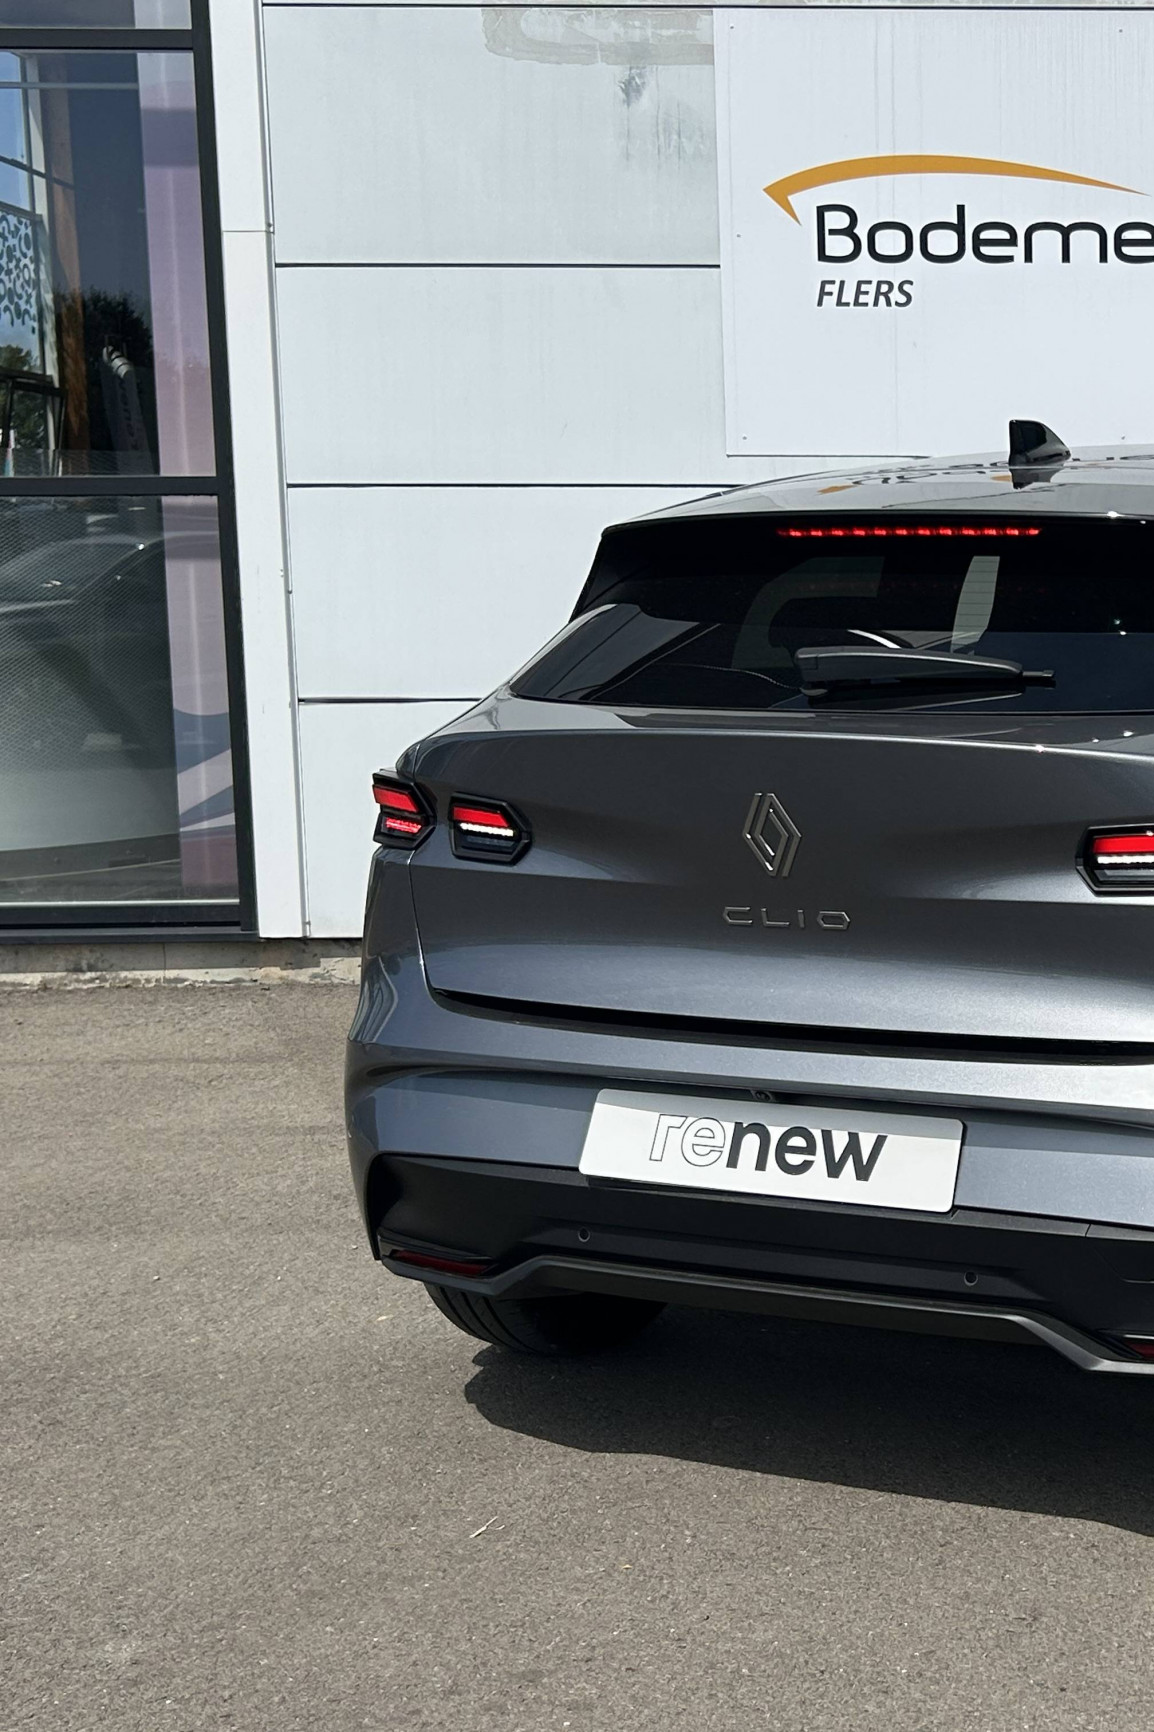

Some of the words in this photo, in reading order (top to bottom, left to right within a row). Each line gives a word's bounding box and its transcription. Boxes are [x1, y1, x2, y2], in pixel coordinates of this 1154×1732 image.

[817, 280, 913, 308] FLERS
[723, 907, 850, 930] CLIO
[649, 1114, 888, 1181] renew
